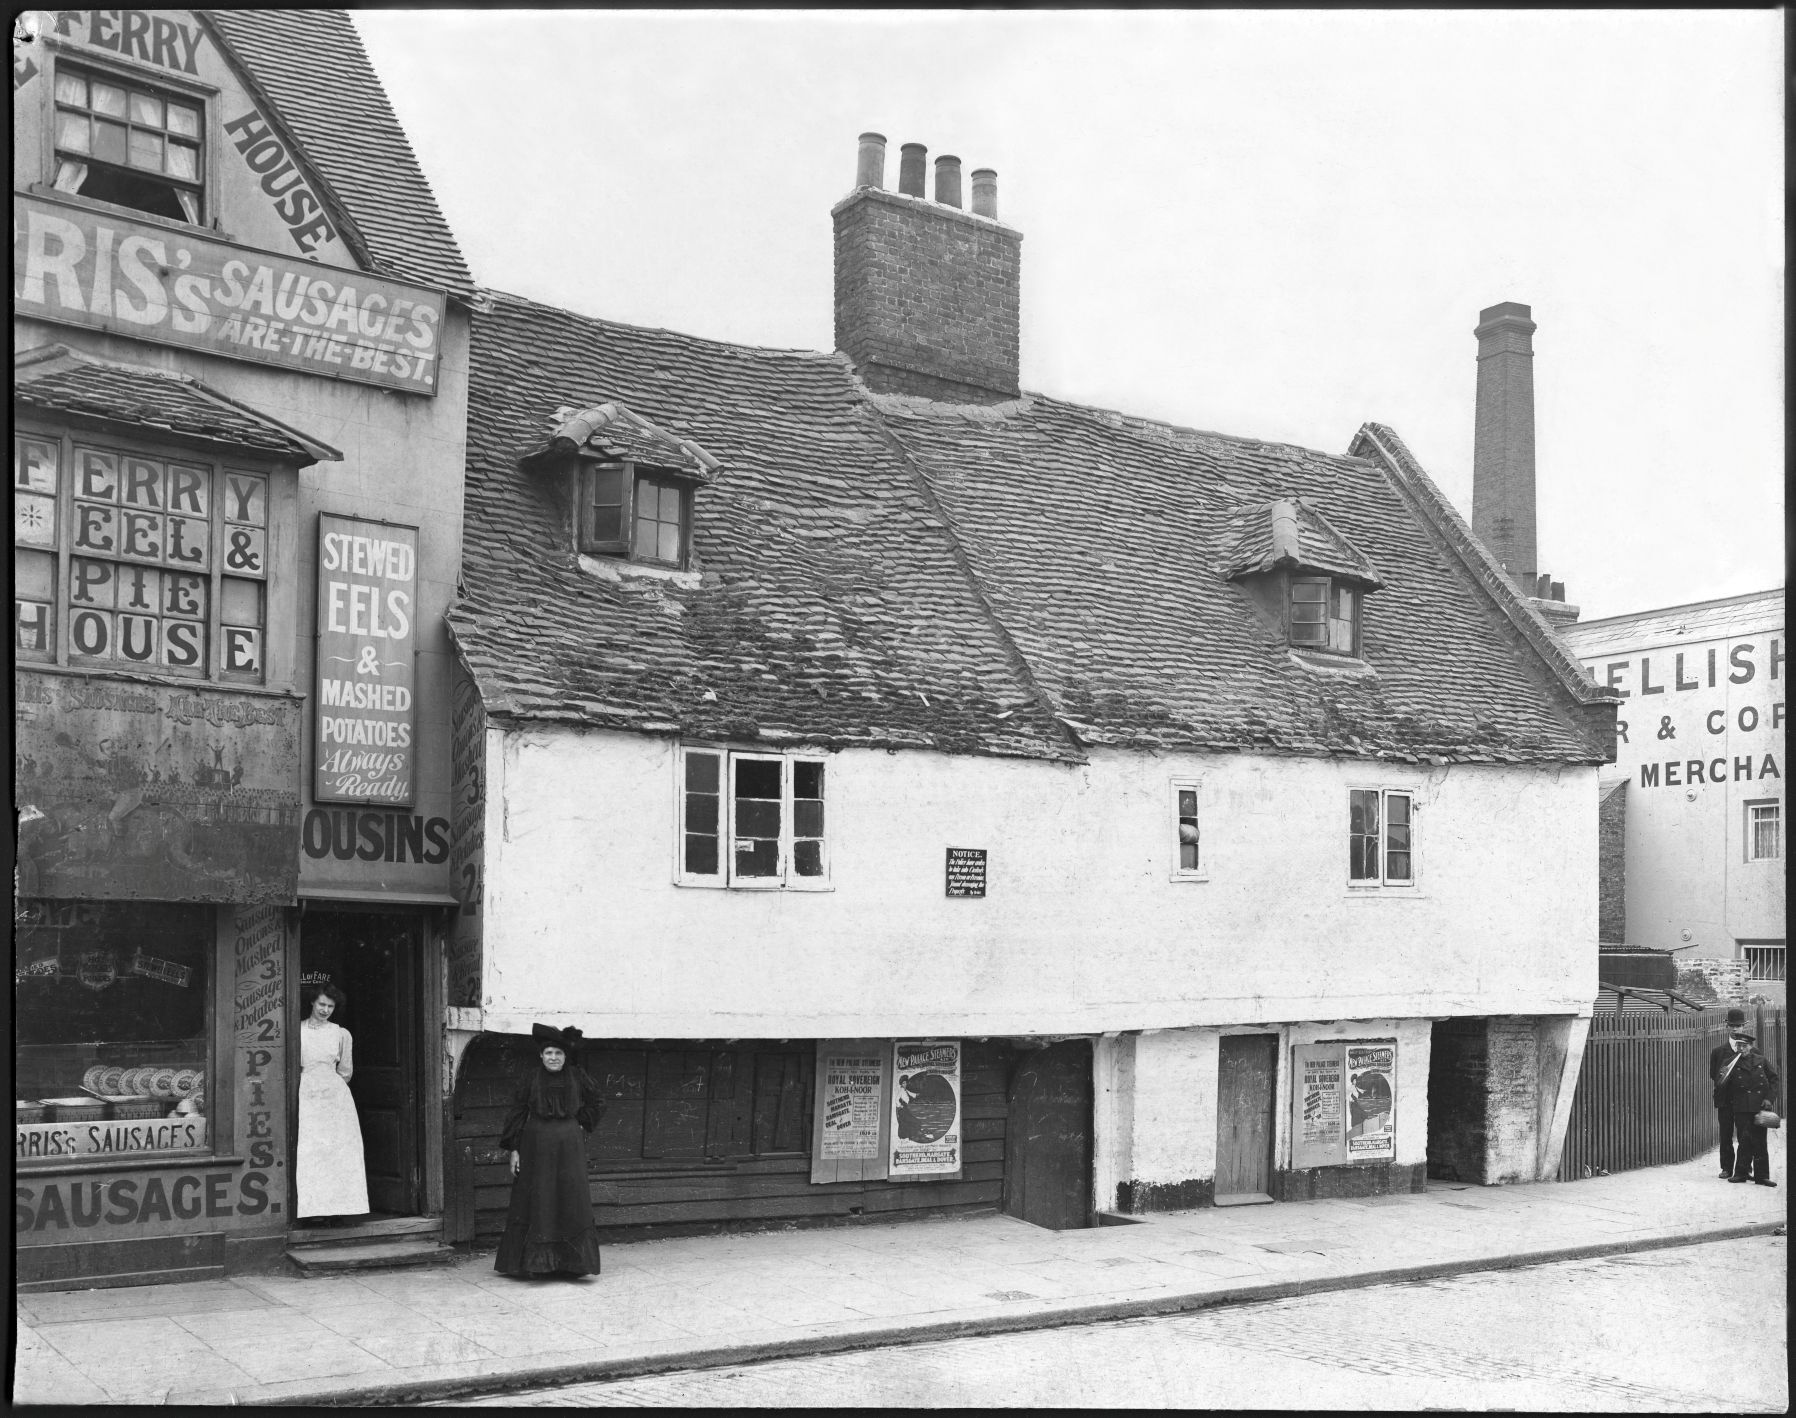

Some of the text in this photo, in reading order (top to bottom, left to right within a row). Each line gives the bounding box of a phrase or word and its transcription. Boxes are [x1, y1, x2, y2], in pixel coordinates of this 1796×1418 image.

[54, 10, 204, 76] FERRY
[213, 260, 439, 348] SAUSAGES
[18, 440, 260, 521] FERRY
[75, 504, 261, 571] EEL &
[323, 532, 415, 582] STEWED
[73, 560, 199, 616] PIE
[328, 581, 410, 640] EELS
[356, 646, 379, 676] &
[321, 678, 412, 712] MASHED
[321, 716, 411, 748] POTATOES
[1657, 715, 1676, 741] &
[320, 749, 405, 779] Always
[1641, 753, 1781, 788] MERCHA
[234, 980, 282, 1013] Sausage
[827, 1074, 846, 1085] ROYAL
[834, 1086, 872, 1094] KOH-I-NOOR
[246, 1050, 284, 1169] PIES.
[88, 1124, 196, 1154] SAUSAGES
